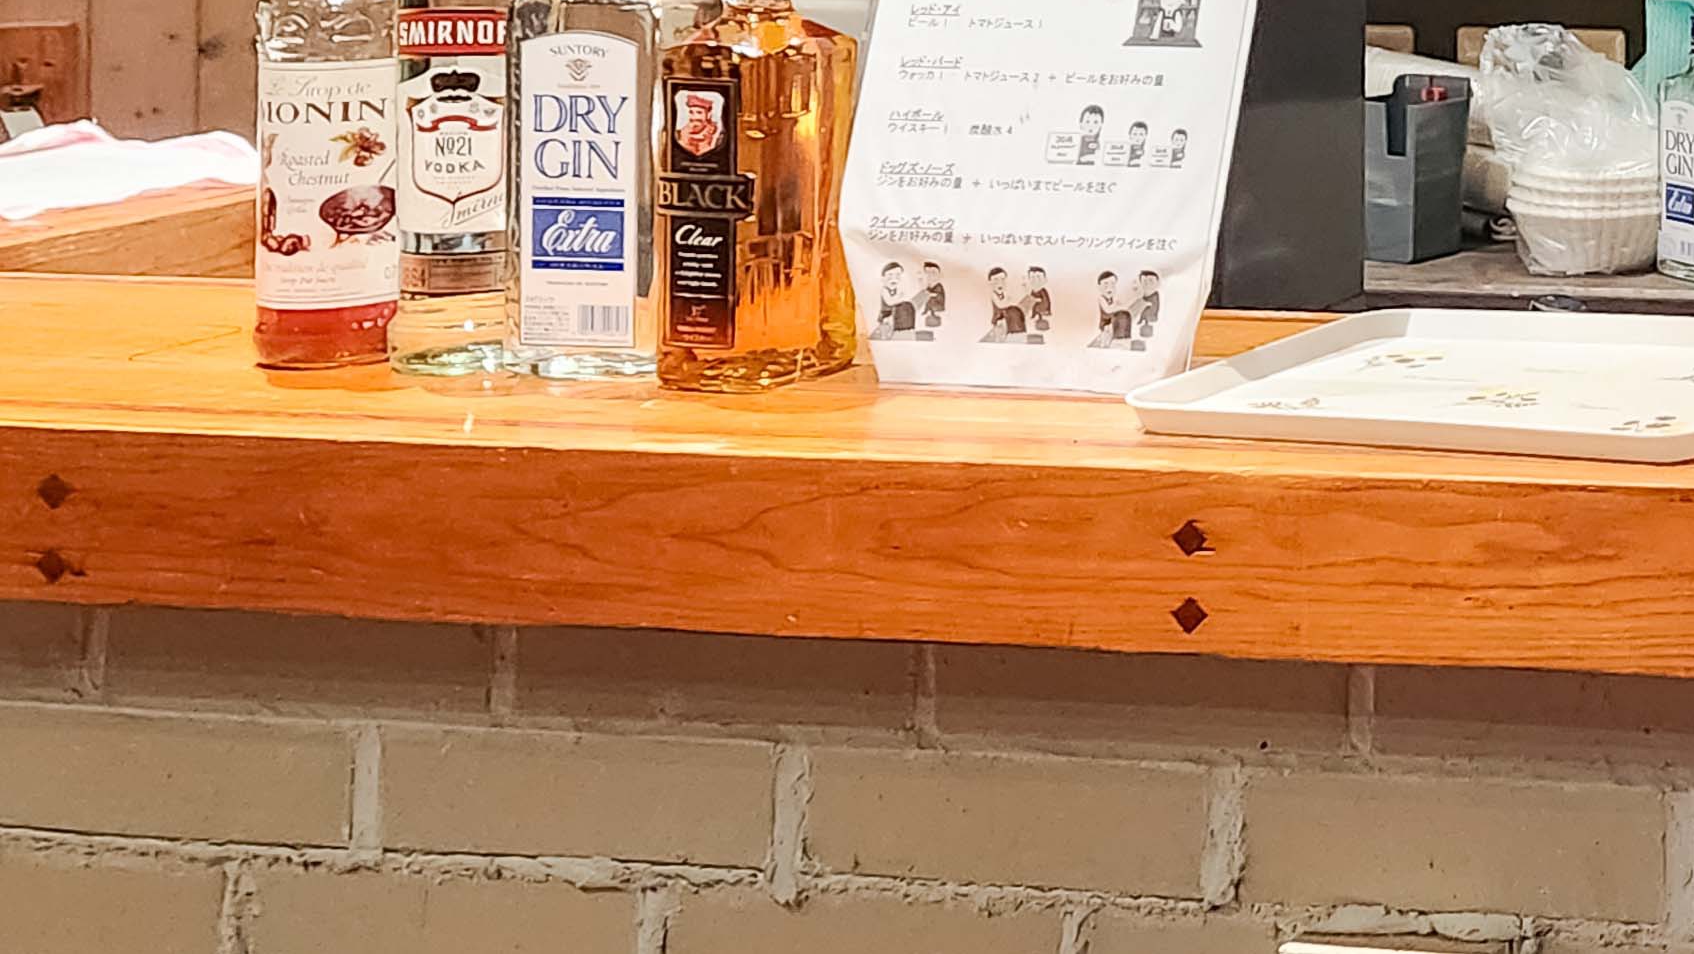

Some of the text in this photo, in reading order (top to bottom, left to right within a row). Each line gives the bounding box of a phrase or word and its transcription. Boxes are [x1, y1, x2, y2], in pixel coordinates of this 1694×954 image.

[549, 44, 607, 58] SUNTORY
[533, 94, 628, 135] DRY
[424, 159, 486, 174] VODKA
[534, 138, 622, 180] GIN
[1665, 153, 1694, 178] GIN
[288, 170, 350, 186] Chestnut
[658, 180, 747, 210] BLACK
[541, 209, 618, 256] Extra
[674, 224, 724, 247] Clear
